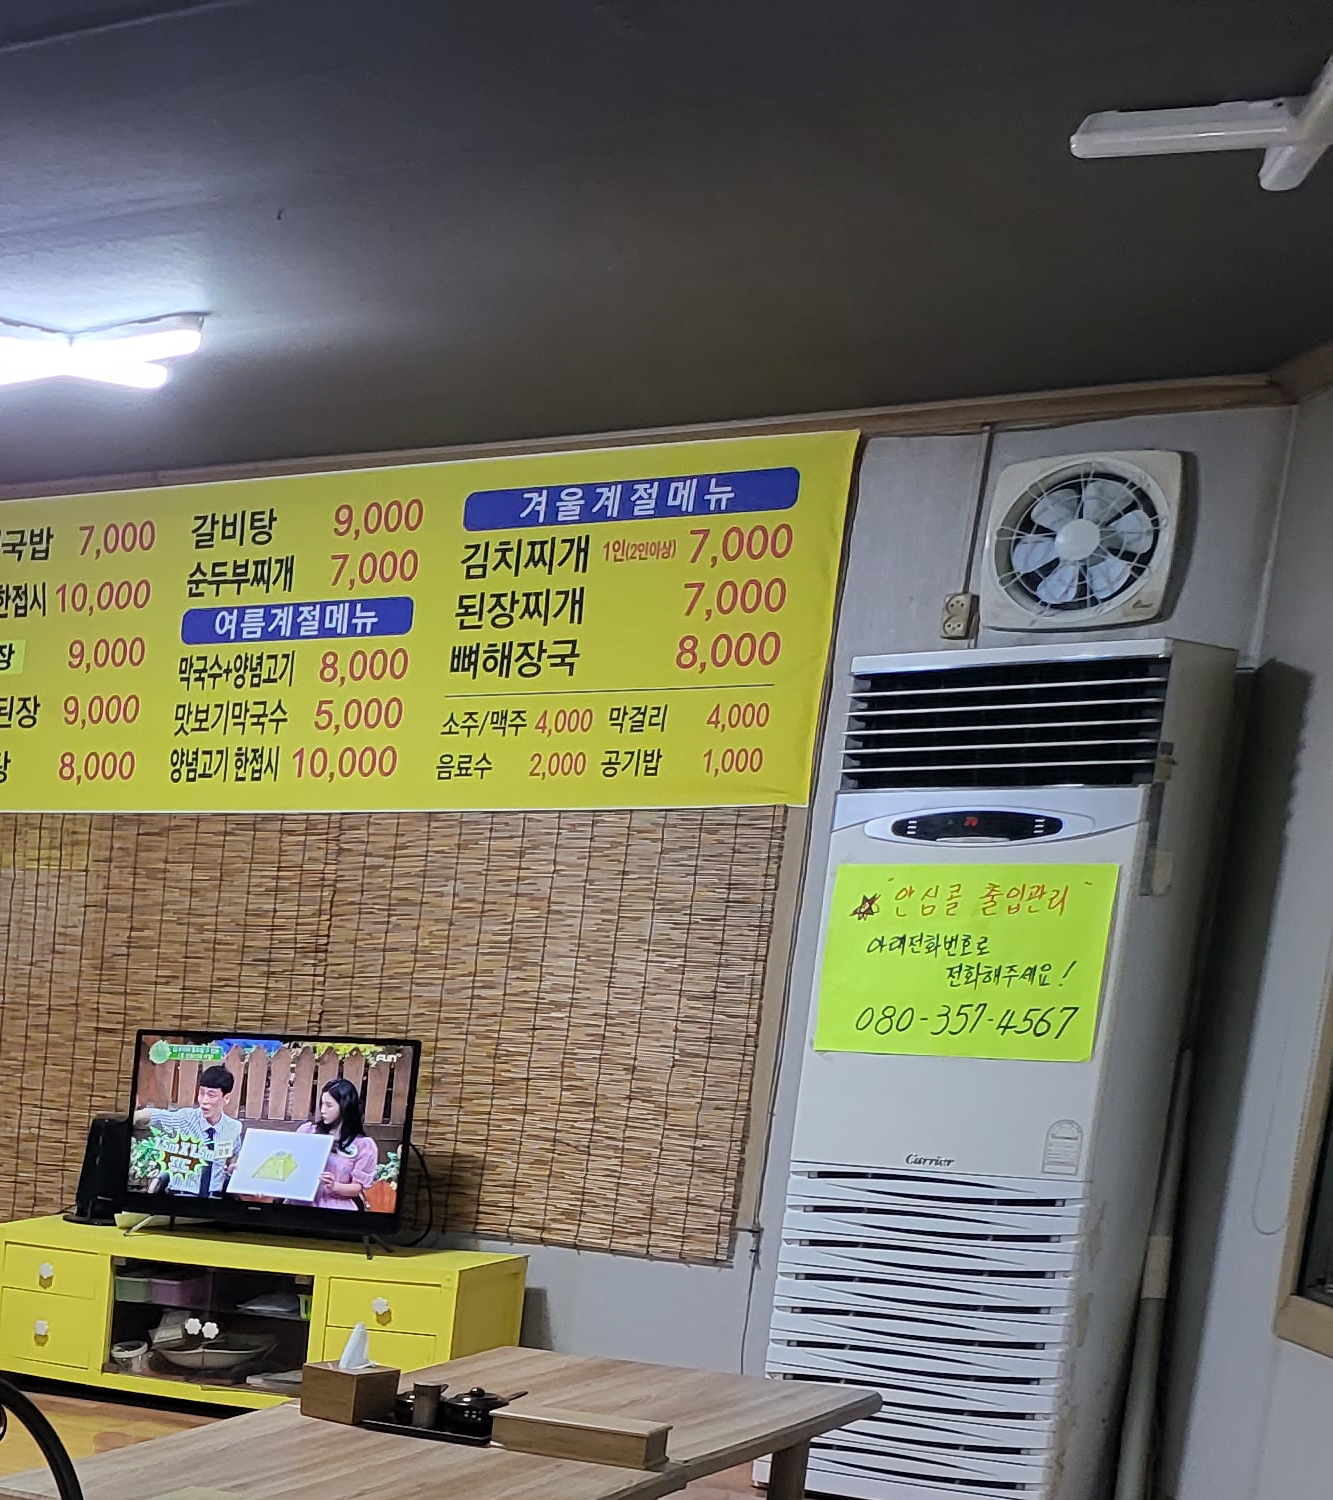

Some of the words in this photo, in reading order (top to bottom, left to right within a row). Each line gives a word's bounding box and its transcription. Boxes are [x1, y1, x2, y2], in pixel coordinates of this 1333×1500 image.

[79, 519, 156, 558] 7,000
[191, 507, 278, 550] 갈비탕
[333, 497, 424, 541] 9,000
[460, 534, 590, 581] 김치찌개
[689, 522, 795, 568] 7,000
[186, 554, 295, 599] 순두부찌개
[330, 548, 420, 590] 7,000
[56, 579, 152, 615] 10,000
[454, 586, 585, 631] 된장찌개
[684, 576, 788, 622] 7,000
[68, 635, 147, 673] 9,000
[318, 647, 410, 687] 8,000
[449, 638, 581, 680] 뼈해장국
[675, 630, 782, 673] 8,000
[62, 694, 141, 729] 9,000
[173, 698, 289, 737] 맛보기막국수
[313, 696, 404, 735] 5,000
[440, 709, 528, 739] 소주/맥주
[534, 708, 594, 737] 4,000
[608, 703, 668, 734] 막걸리
[707, 702, 770, 731] 4,000
[58, 750, 136, 784] 8,000
[170, 746, 229, 784] 양념고기
[234, 745, 280, 783] 한접시
[292, 745, 398, 783] 10,000
[435, 752, 493, 781] 음료수
[529, 751, 588, 778] 2,000
[600, 747, 663, 778] 공기밥
[704, 747, 765, 777] 1,000
[855, 1003, 1080, 1040] 080-357-4567
